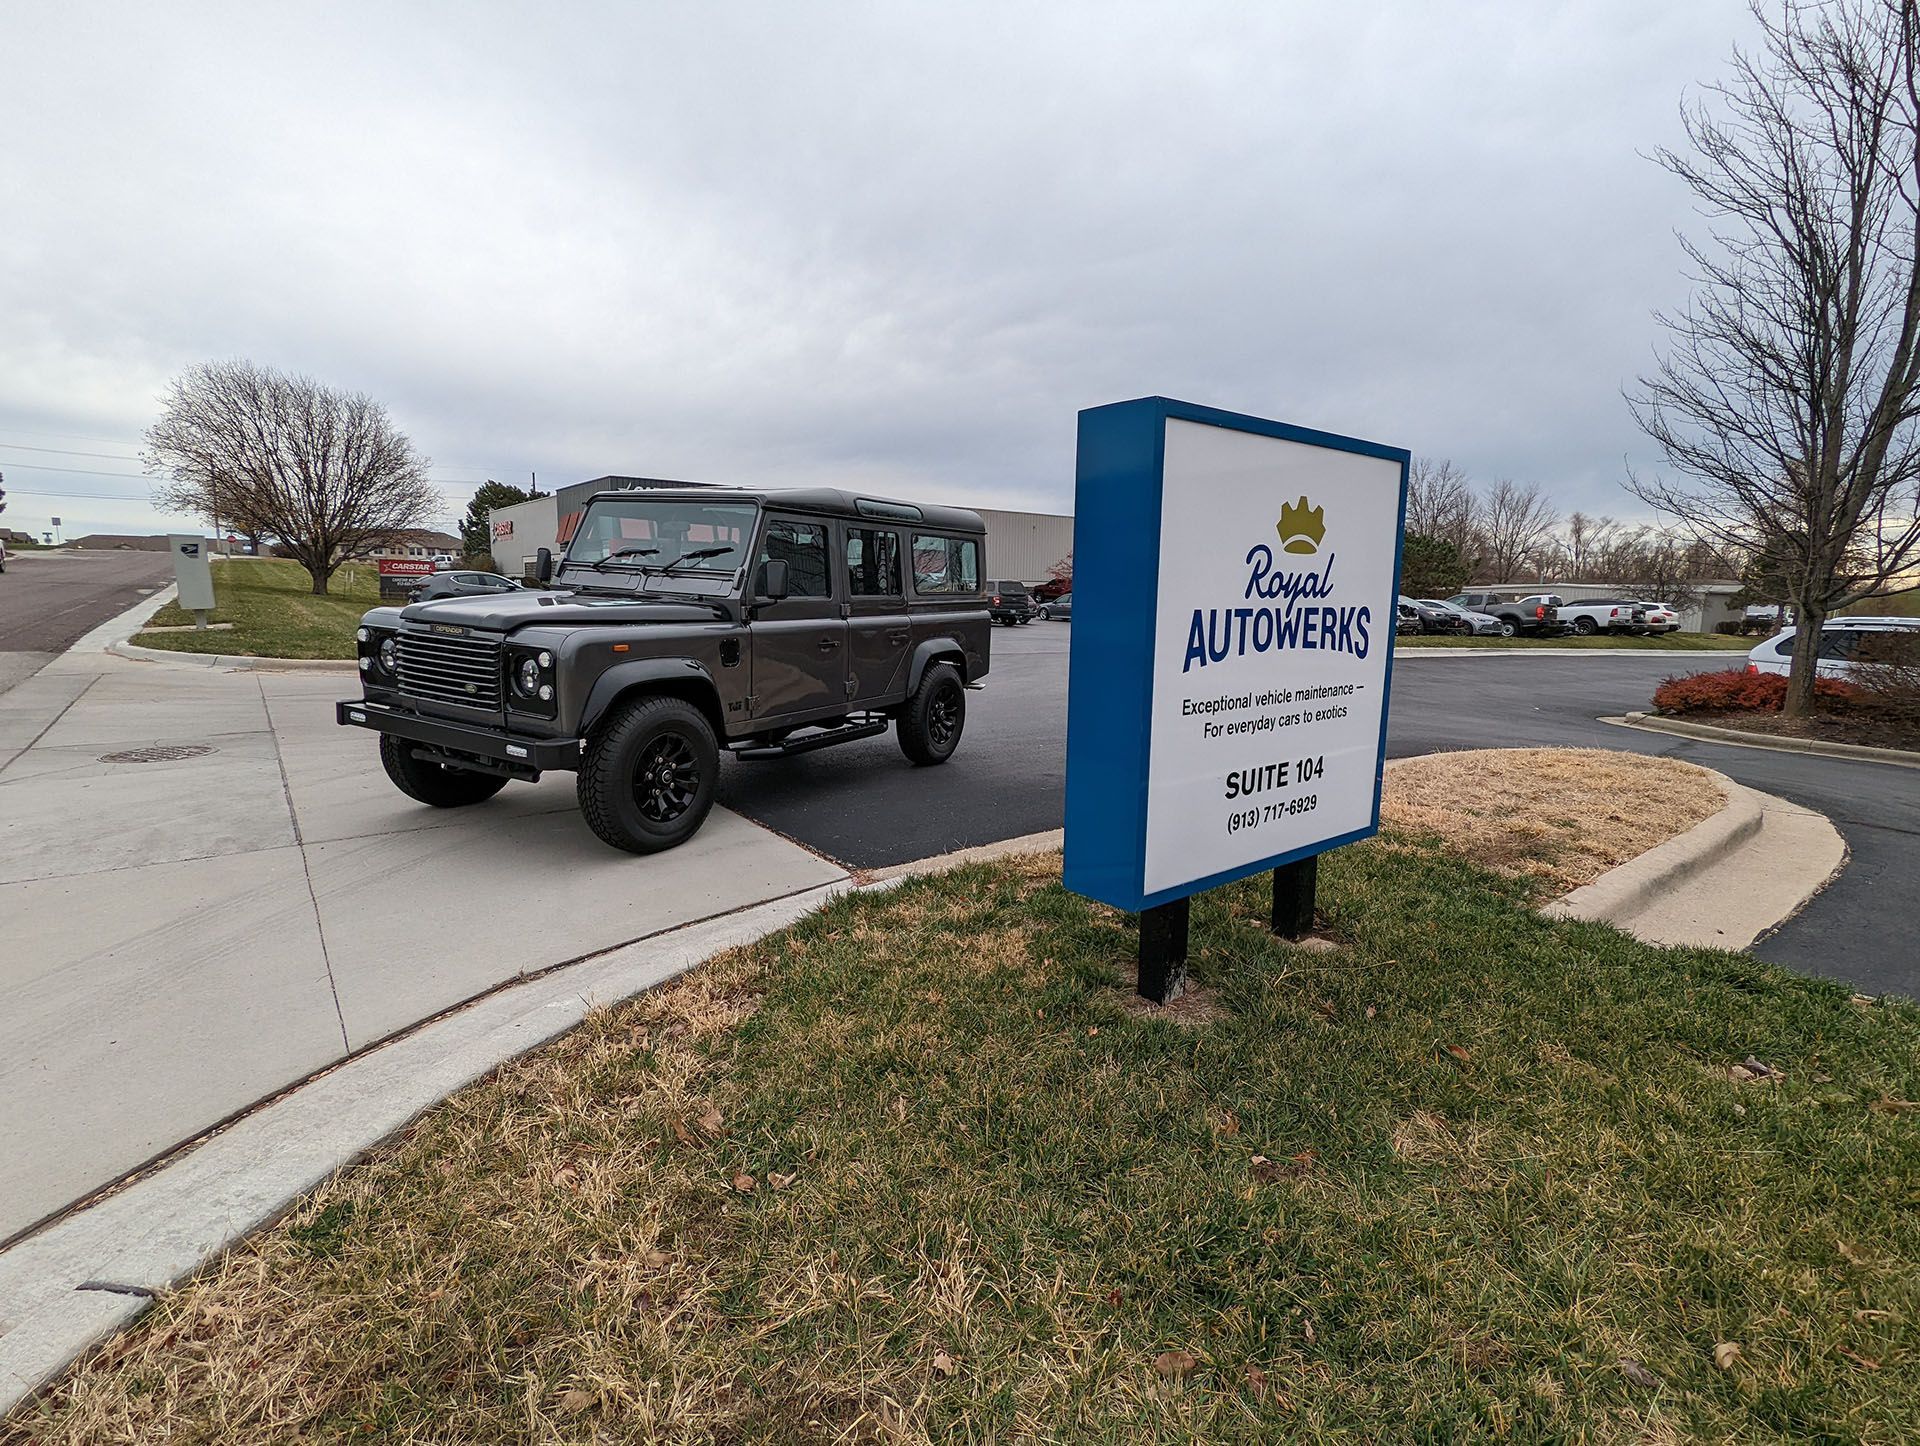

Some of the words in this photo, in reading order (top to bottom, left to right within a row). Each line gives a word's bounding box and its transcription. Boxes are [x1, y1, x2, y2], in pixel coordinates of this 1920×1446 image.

[1245, 544, 1335, 618] Royal
[435, 625, 463, 634] DEFENDER
[1182, 606, 1371, 673] AUTOWERKS
[1182, 692, 1252, 716] Exceptional
[1255, 688, 1292, 707] vehicle
[1294, 684, 1354, 702] maintenance
[1203, 722, 1225, 738] For
[1226, 715, 1276, 735] everyday
[1278, 714, 1301, 728] cars
[1302, 710, 1313, 724] to
[1315, 705, 1348, 722] exotics
[1224, 762, 1290, 800] SUITE
[1295, 756, 1324, 783] 104
[1227, 807, 1260, 835] (913)
[1263, 795, 1317, 823] 717-6929
